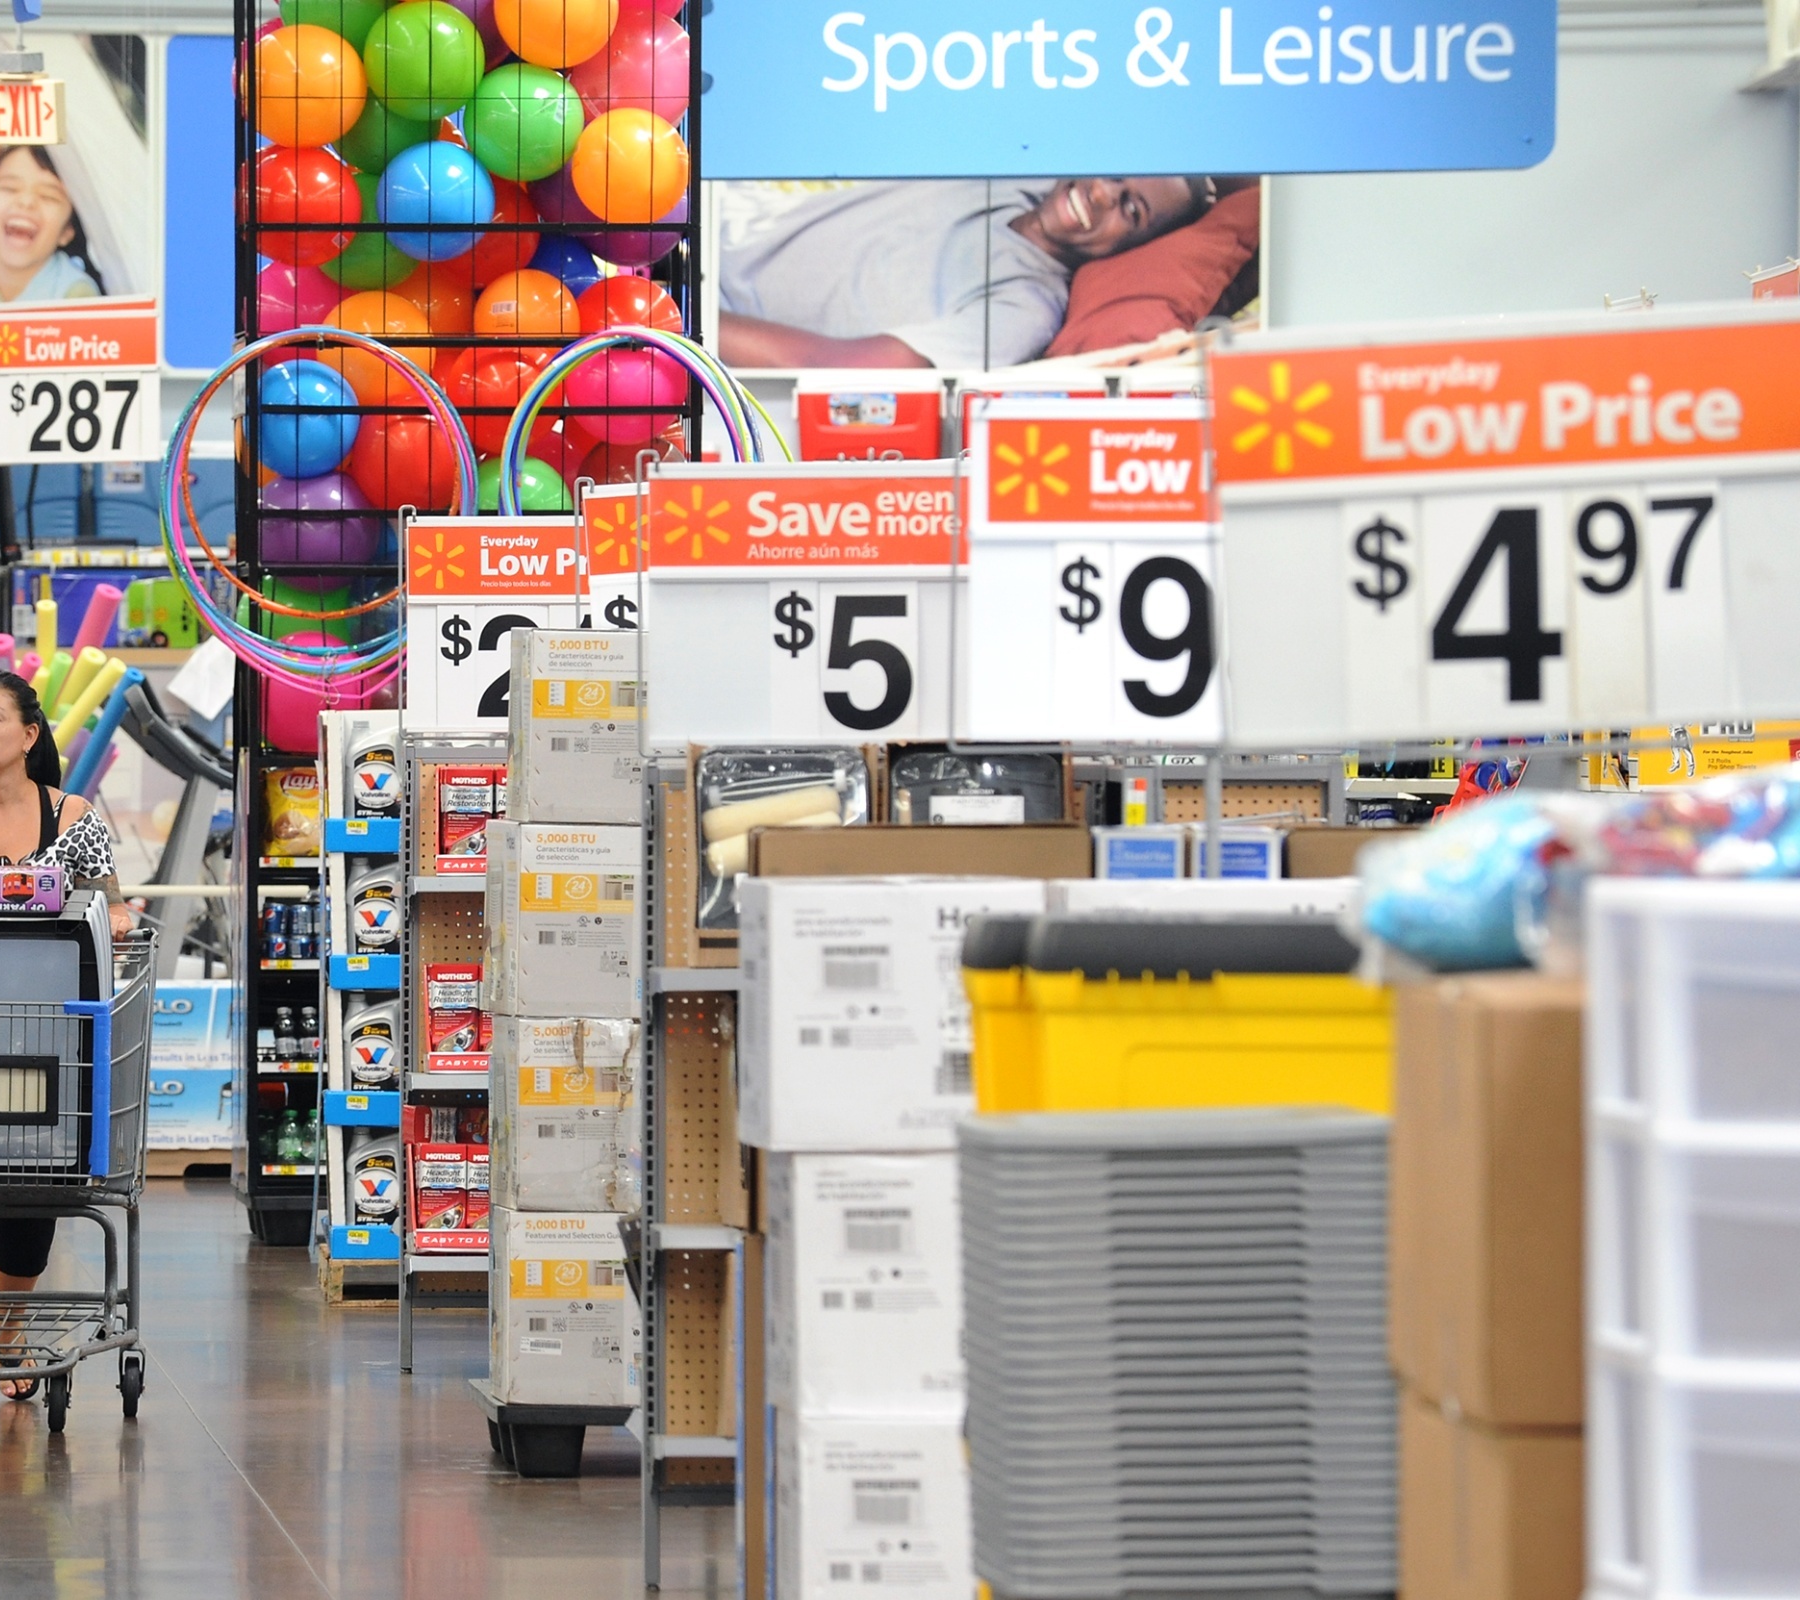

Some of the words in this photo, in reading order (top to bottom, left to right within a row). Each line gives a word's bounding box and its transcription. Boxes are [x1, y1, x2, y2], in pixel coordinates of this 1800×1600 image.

[821, 12, 1099, 112] Sports
[1126, 7, 1191, 88] &
[1219, 6, 1515, 85] Leisure
[24, 337, 66, 361] Low
[69, 334, 120, 360] Price
[1358, 358, 1500, 394] Everyday
[1360, 388, 1526, 460] Low
[1540, 374, 1743, 450] Price
[1090, 429, 1177, 452] Everyday
[1090, 449, 1192, 494] Low
[747, 491, 871, 537] Save
[877, 491, 955, 513] even
[877, 514, 963, 536] more
[480, 536, 538, 549] Everyday
[747, 544, 805, 560] Ahorre
[808, 543, 840, 559] aún
[844, 543, 879, 559] más
[480, 549, 549, 576] Low
[480, 580, 498, 588] Precio
[549, 640, 582, 651] 5,000
[584, 640, 609, 650] BTU
[773, 591, 913, 731] $5
[584, 688, 599, 697] 24
[1171, 756, 1196, 765] GTX
[283, 774, 319, 790] Lay
[452, 793, 487, 801] Headlight
[536, 833, 569, 845] 5,000
[571, 833, 596, 844] BTU
[590, 847, 595, 855] y
[546, 853, 579, 861] selección
[571, 881, 586, 891] 24
[438, 989, 473, 997] Headlight
[362, 1026, 371, 1035] 5
[367, 1158, 375, 1167] 5
[425, 1153, 461, 1161] MOTHERS
[425, 1169, 461, 1178] Headlight
[525, 1219, 558, 1230] 5,000
[560, 1219, 586, 1230] BTU
[422, 1236, 455, 1244] EASY
[525, 1231, 556, 1239] Features
[558, 1231, 571, 1239] and
[572, 1231, 603, 1239] Selection
[604, 1231, 623, 1239] Gui
[562, 1267, 576, 1277] 24
